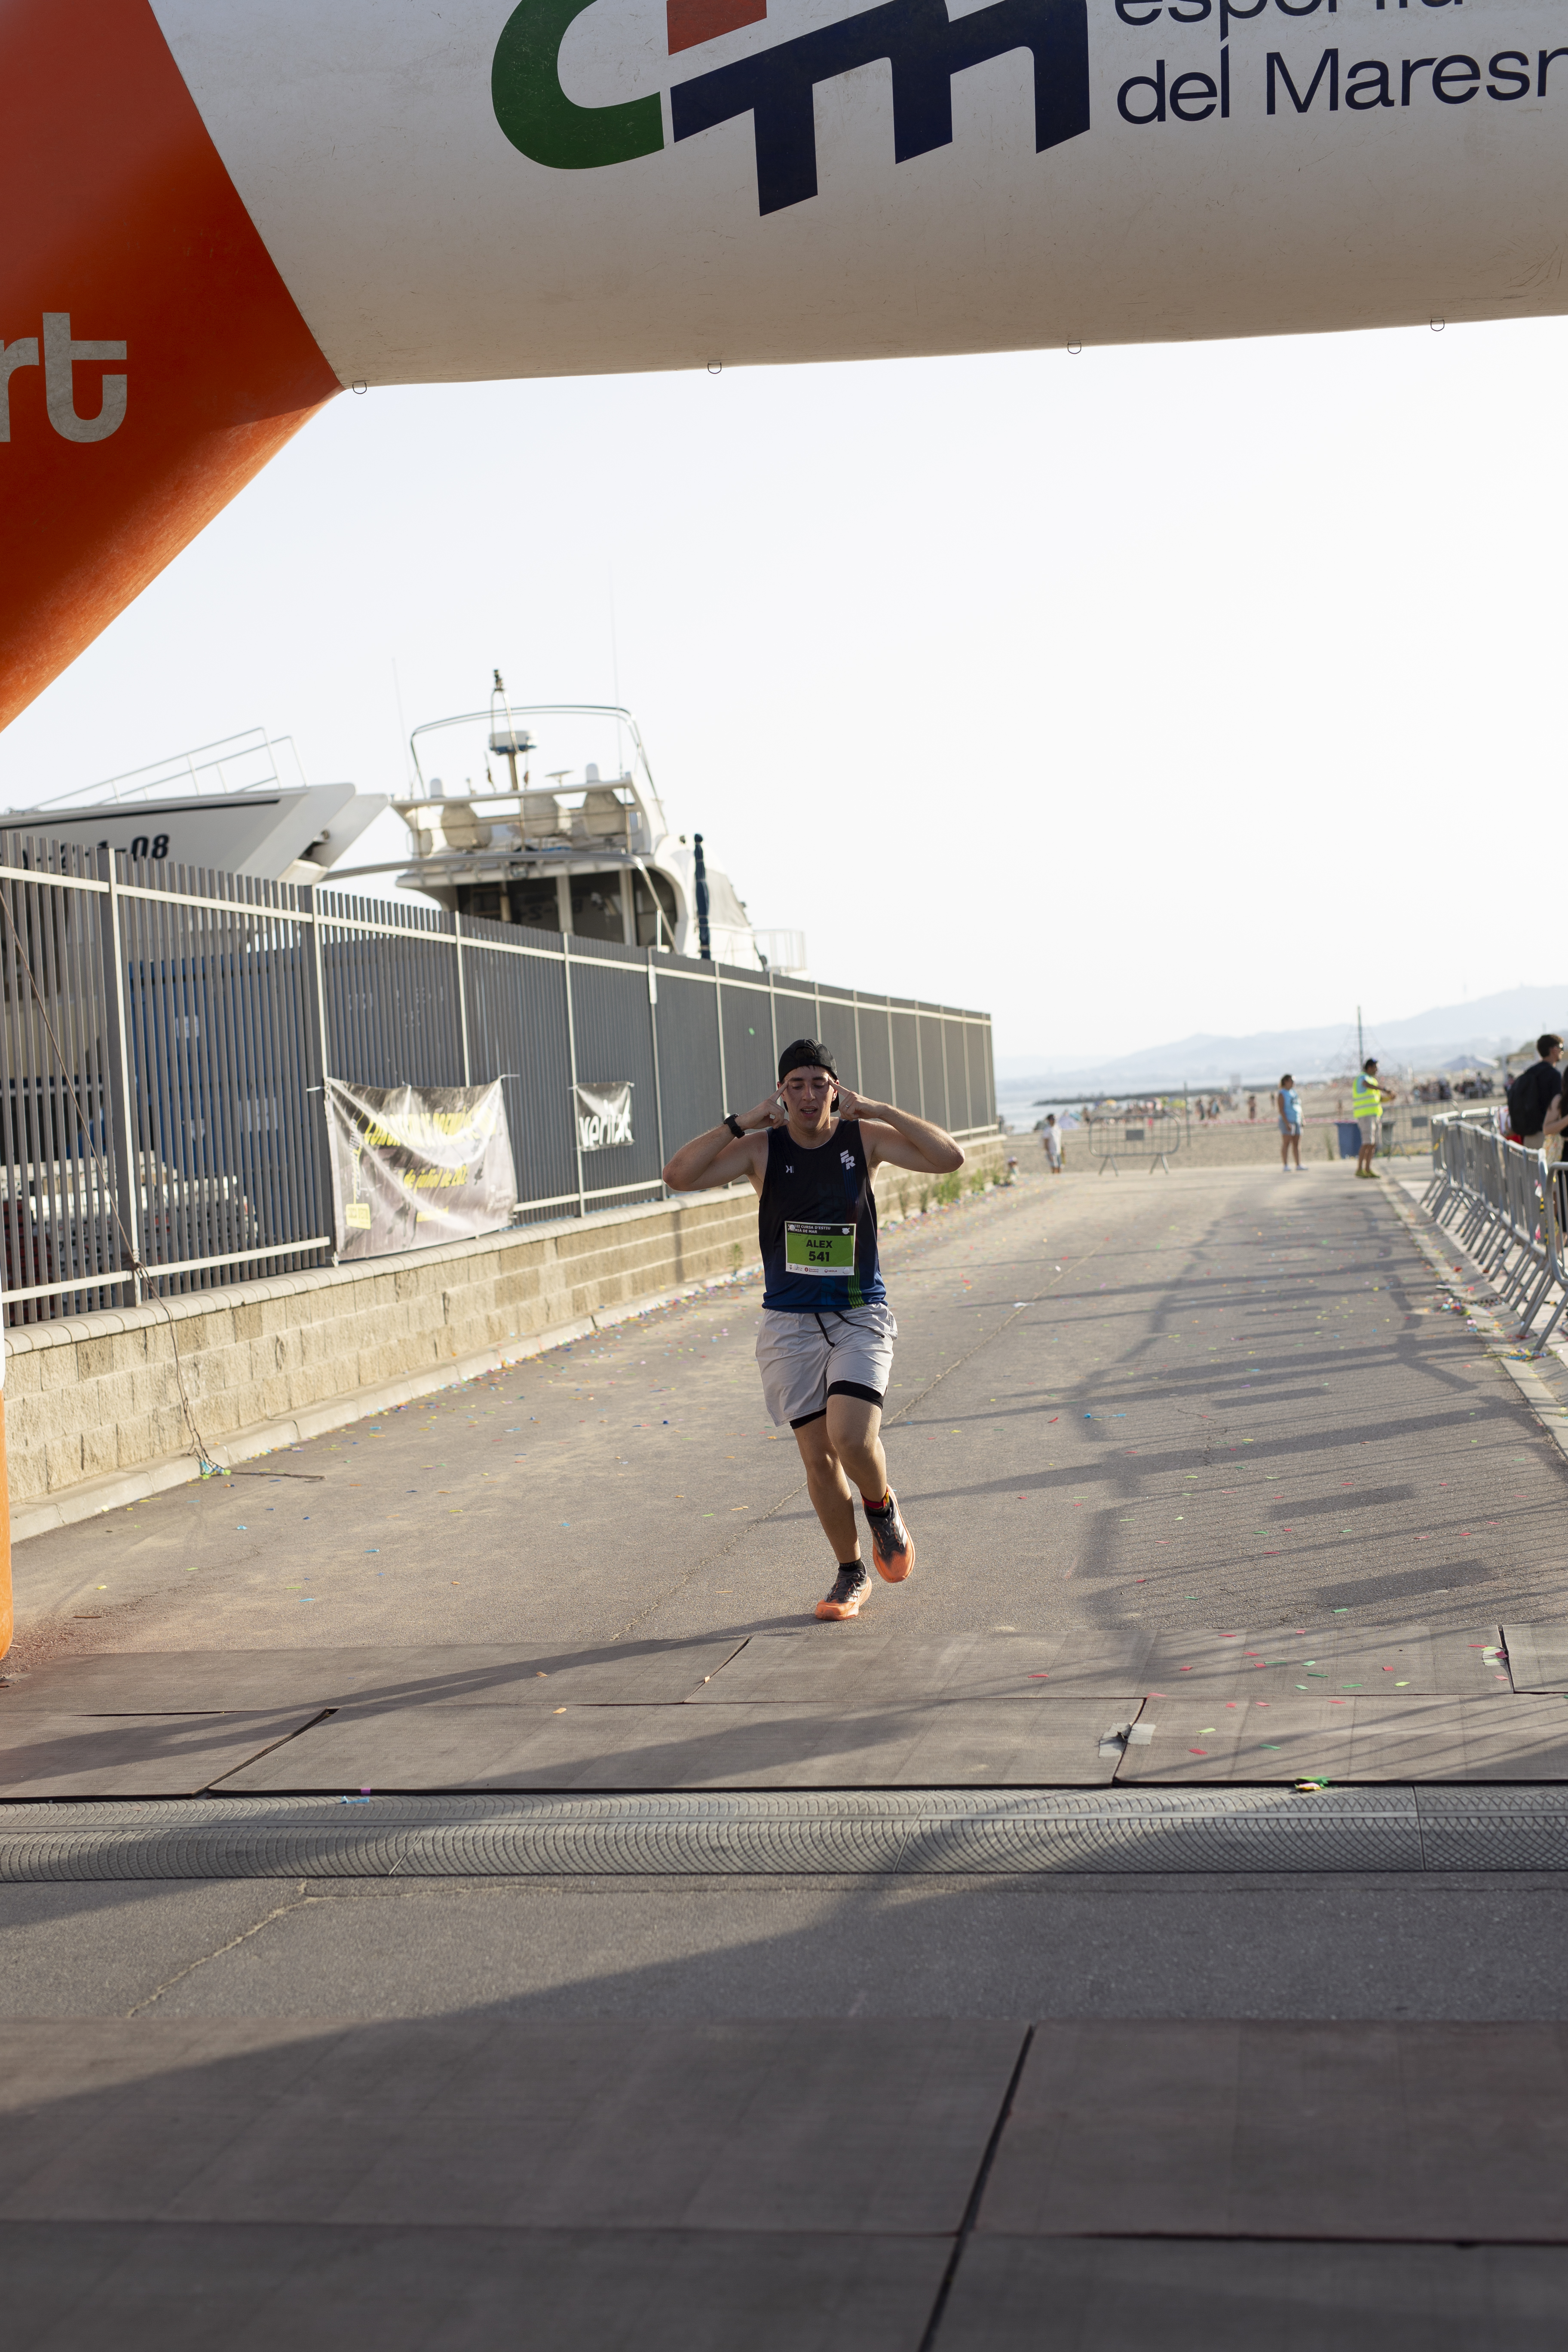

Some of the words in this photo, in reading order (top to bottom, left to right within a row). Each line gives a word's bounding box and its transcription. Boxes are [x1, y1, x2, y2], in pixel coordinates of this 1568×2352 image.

[1117, 43, 1230, 125] del
[806, 1240, 833, 1248] ALEX
[808, 1251, 830, 1262] 541
